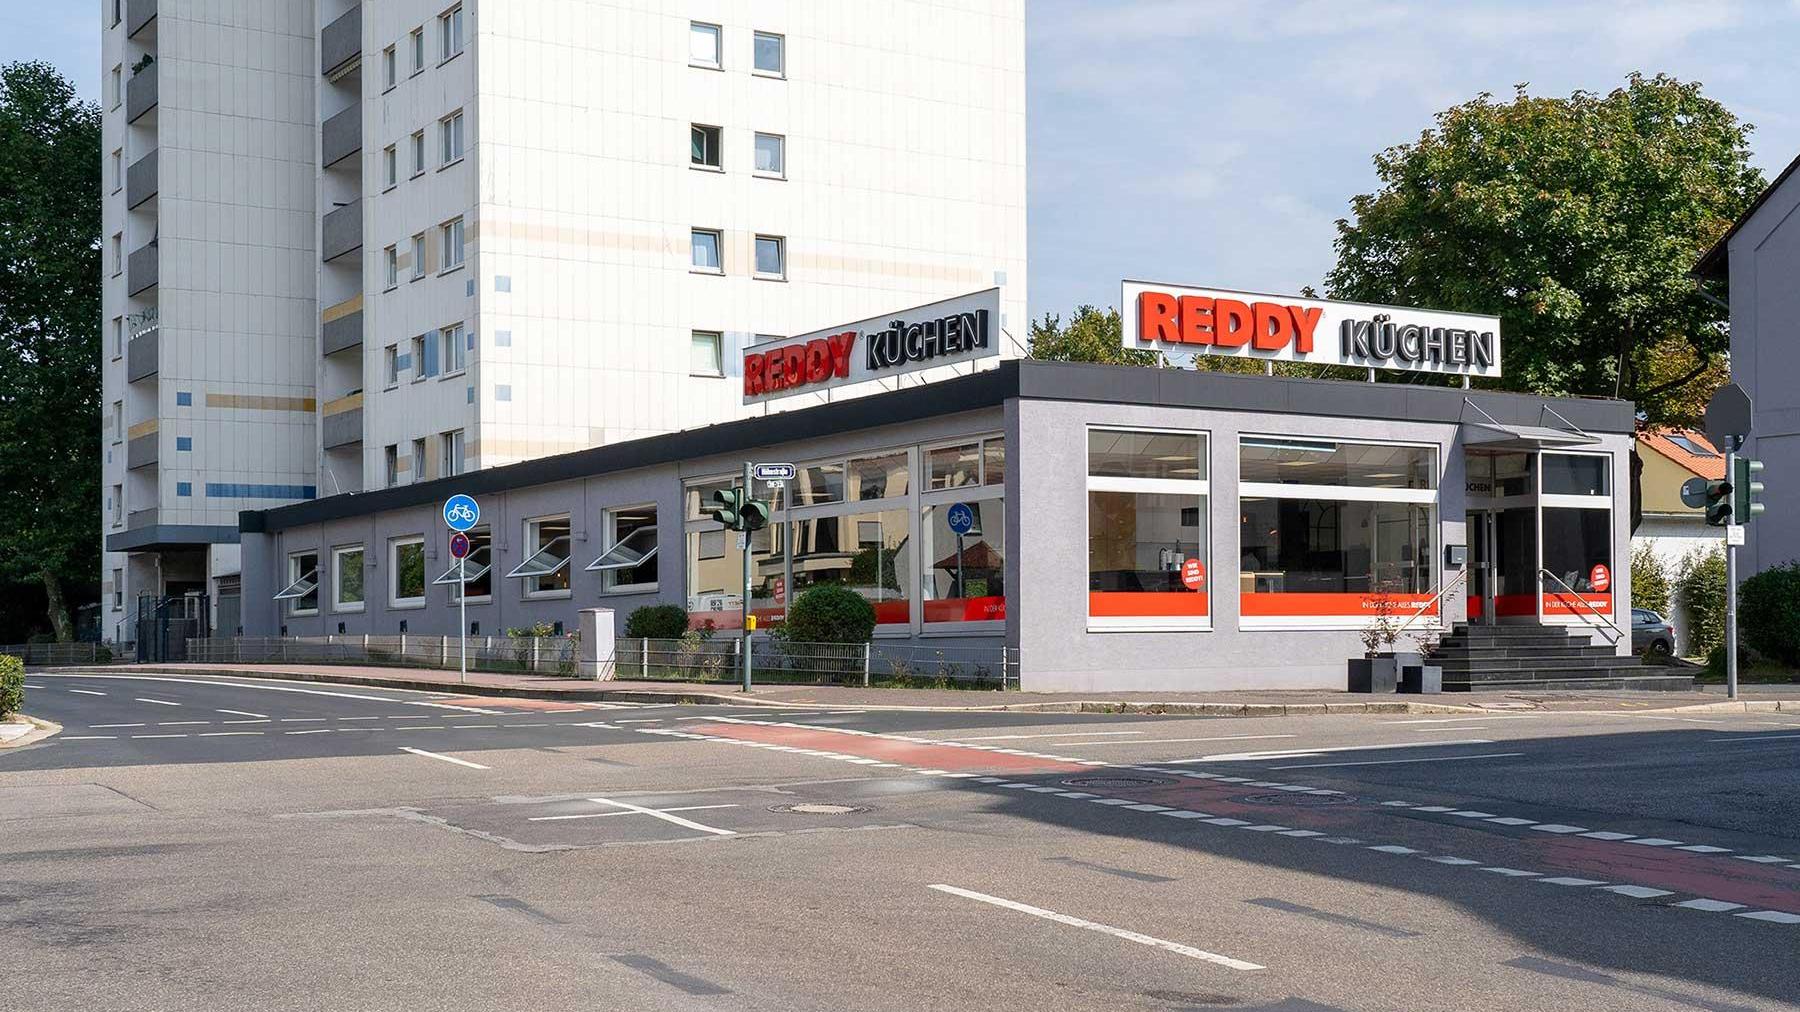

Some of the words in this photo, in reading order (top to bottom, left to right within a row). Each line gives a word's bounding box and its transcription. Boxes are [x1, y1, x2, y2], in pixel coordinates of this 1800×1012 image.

[744, 331, 857, 396] REDDY
[866, 309, 989, 371] KÜCHEN
[1139, 291, 1323, 353] REDDY
[1341, 313, 1494, 367] KÜCHEN
